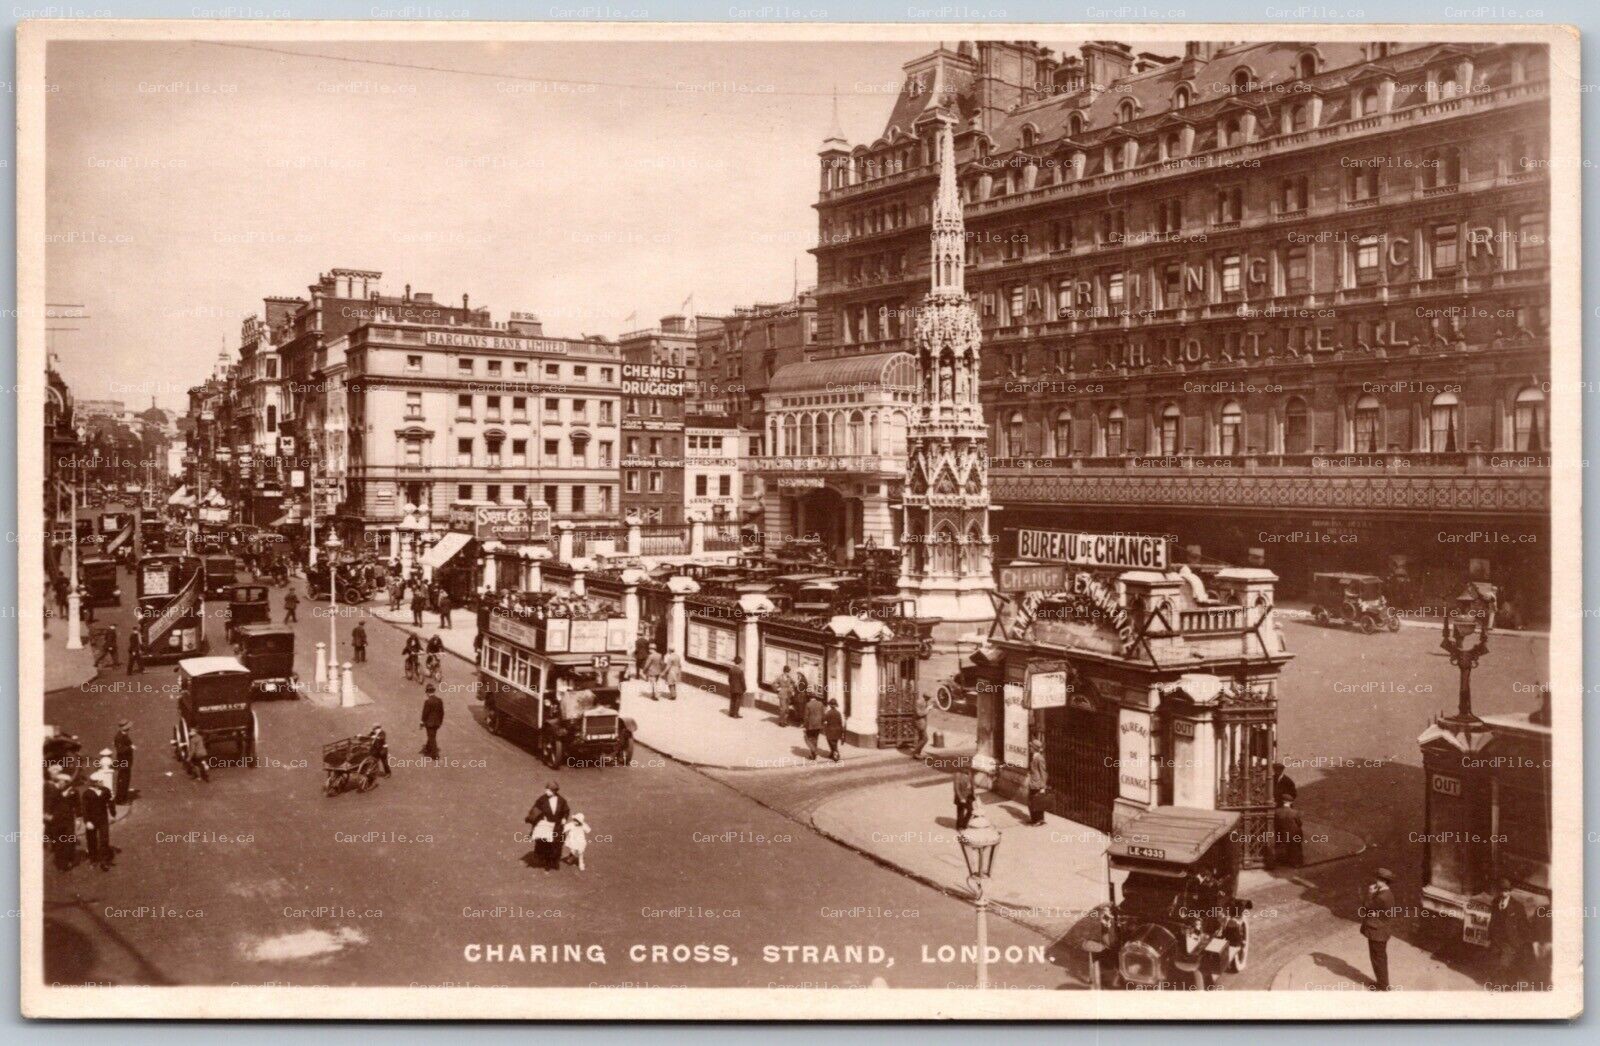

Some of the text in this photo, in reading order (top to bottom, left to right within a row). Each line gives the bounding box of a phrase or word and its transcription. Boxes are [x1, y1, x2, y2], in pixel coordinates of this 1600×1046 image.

[430, 332, 564, 353] BARCLAYS BANK LIMITED
[1130, 321, 1410, 367] HOTEL
[622, 364, 685, 380] CHEMIST
[622, 380, 685, 396] DRUGGIST
[1021, 530, 1163, 568] BUREAU DE CHANGE
[593, 656, 609, 668] 15
[1175, 721, 1193, 736] OUT
[1121, 774, 1147, 791] CHANGE
[1434, 777, 1459, 794] OUT
